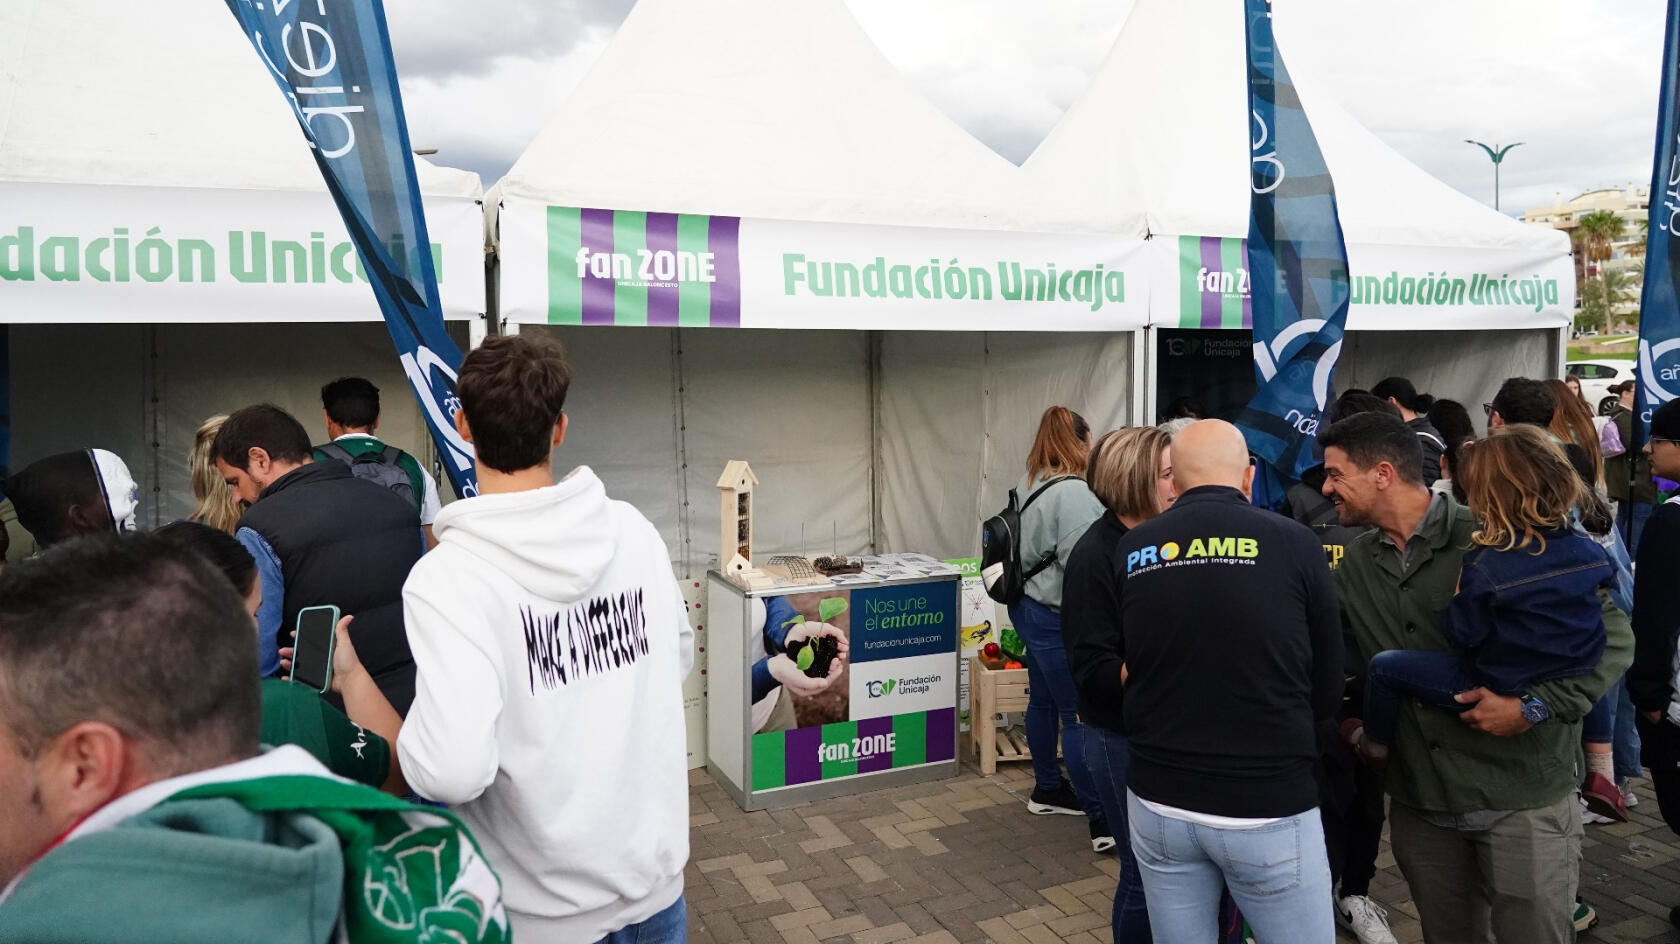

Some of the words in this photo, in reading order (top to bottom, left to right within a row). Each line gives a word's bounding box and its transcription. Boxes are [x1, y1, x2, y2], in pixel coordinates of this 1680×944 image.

[575, 247, 633, 280] fan
[637, 249, 717, 282] ZONE
[782, 252, 993, 301] Fundación
[998, 260, 1125, 312] Unicaja
[1196, 267, 1235, 293] fan
[1330, 270, 1467, 306] Fundación
[1468, 272, 1559, 313] Unicaja
[1204, 348, 1241, 358] Unicaja
[1185, 537, 1260, 558] AMB
[1165, 557, 1208, 568] Ambiental
[1211, 557, 1257, 566] Integrada
[865, 598, 896, 614] Nos
[897, 596, 927, 611] une
[865, 614, 878, 631] el
[881, 611, 944, 629] entorno
[519, 603, 567, 696] MAKE
[567, 608, 580, 681] A
[574, 586, 649, 678] DIFFERENCE
[864, 634, 942, 649] fundacionunicaja.com
[898, 674, 942, 687] Fundación
[898, 683, 930, 695] Unicaja
[818, 743, 849, 763] fan
[852, 732, 896, 757] ZONE
